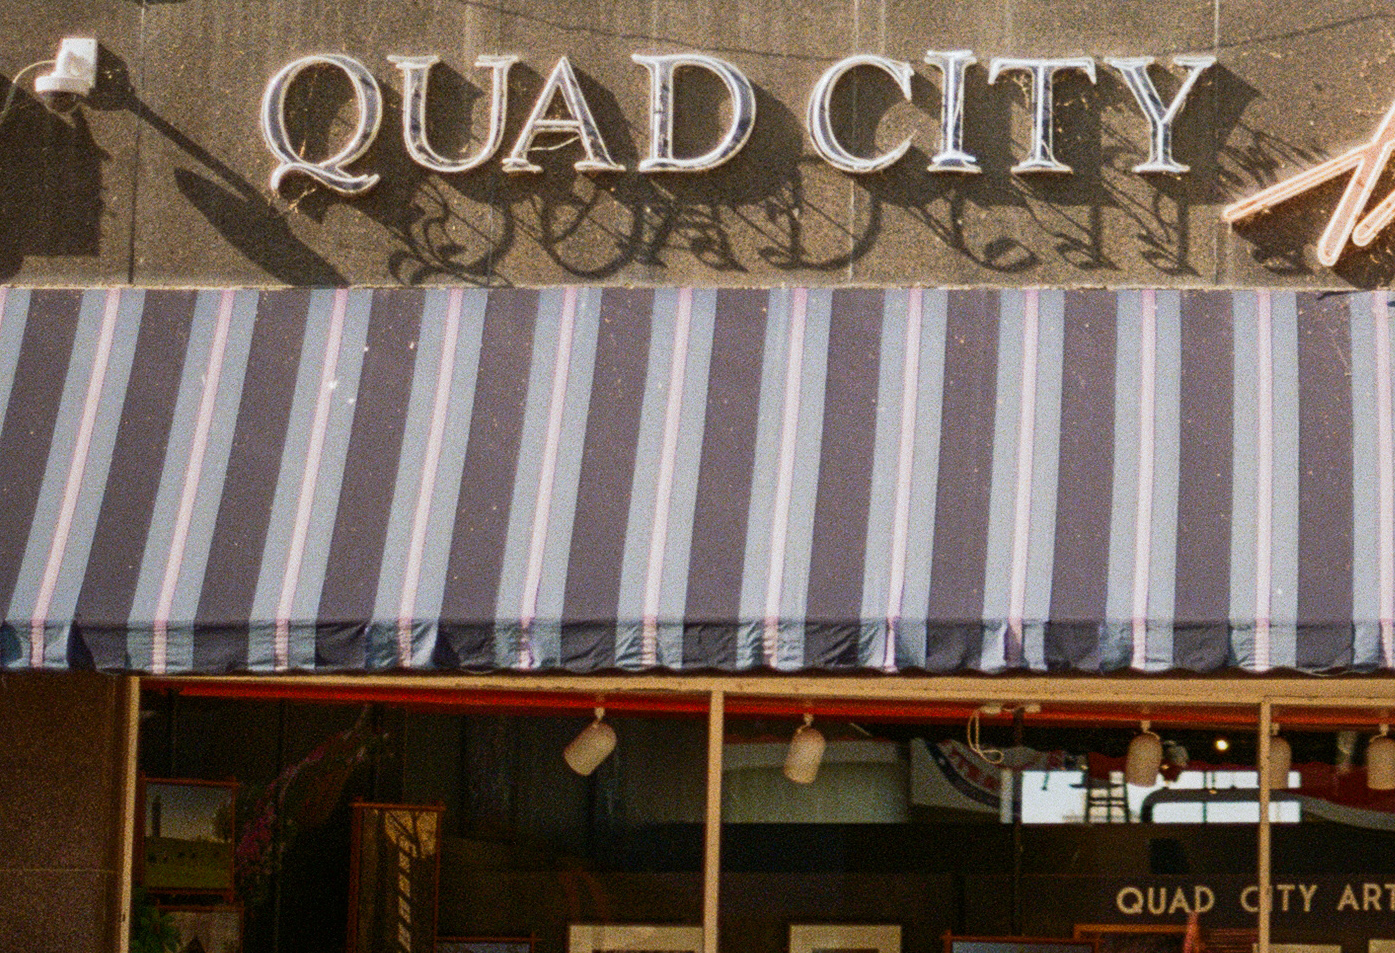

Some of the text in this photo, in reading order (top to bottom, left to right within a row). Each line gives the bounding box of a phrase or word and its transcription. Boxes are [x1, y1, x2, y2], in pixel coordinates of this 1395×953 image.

[261, 52, 757, 196] QUAD
[806, 49, 1217, 175] CITY
[1116, 886, 1216, 915] QUAD
